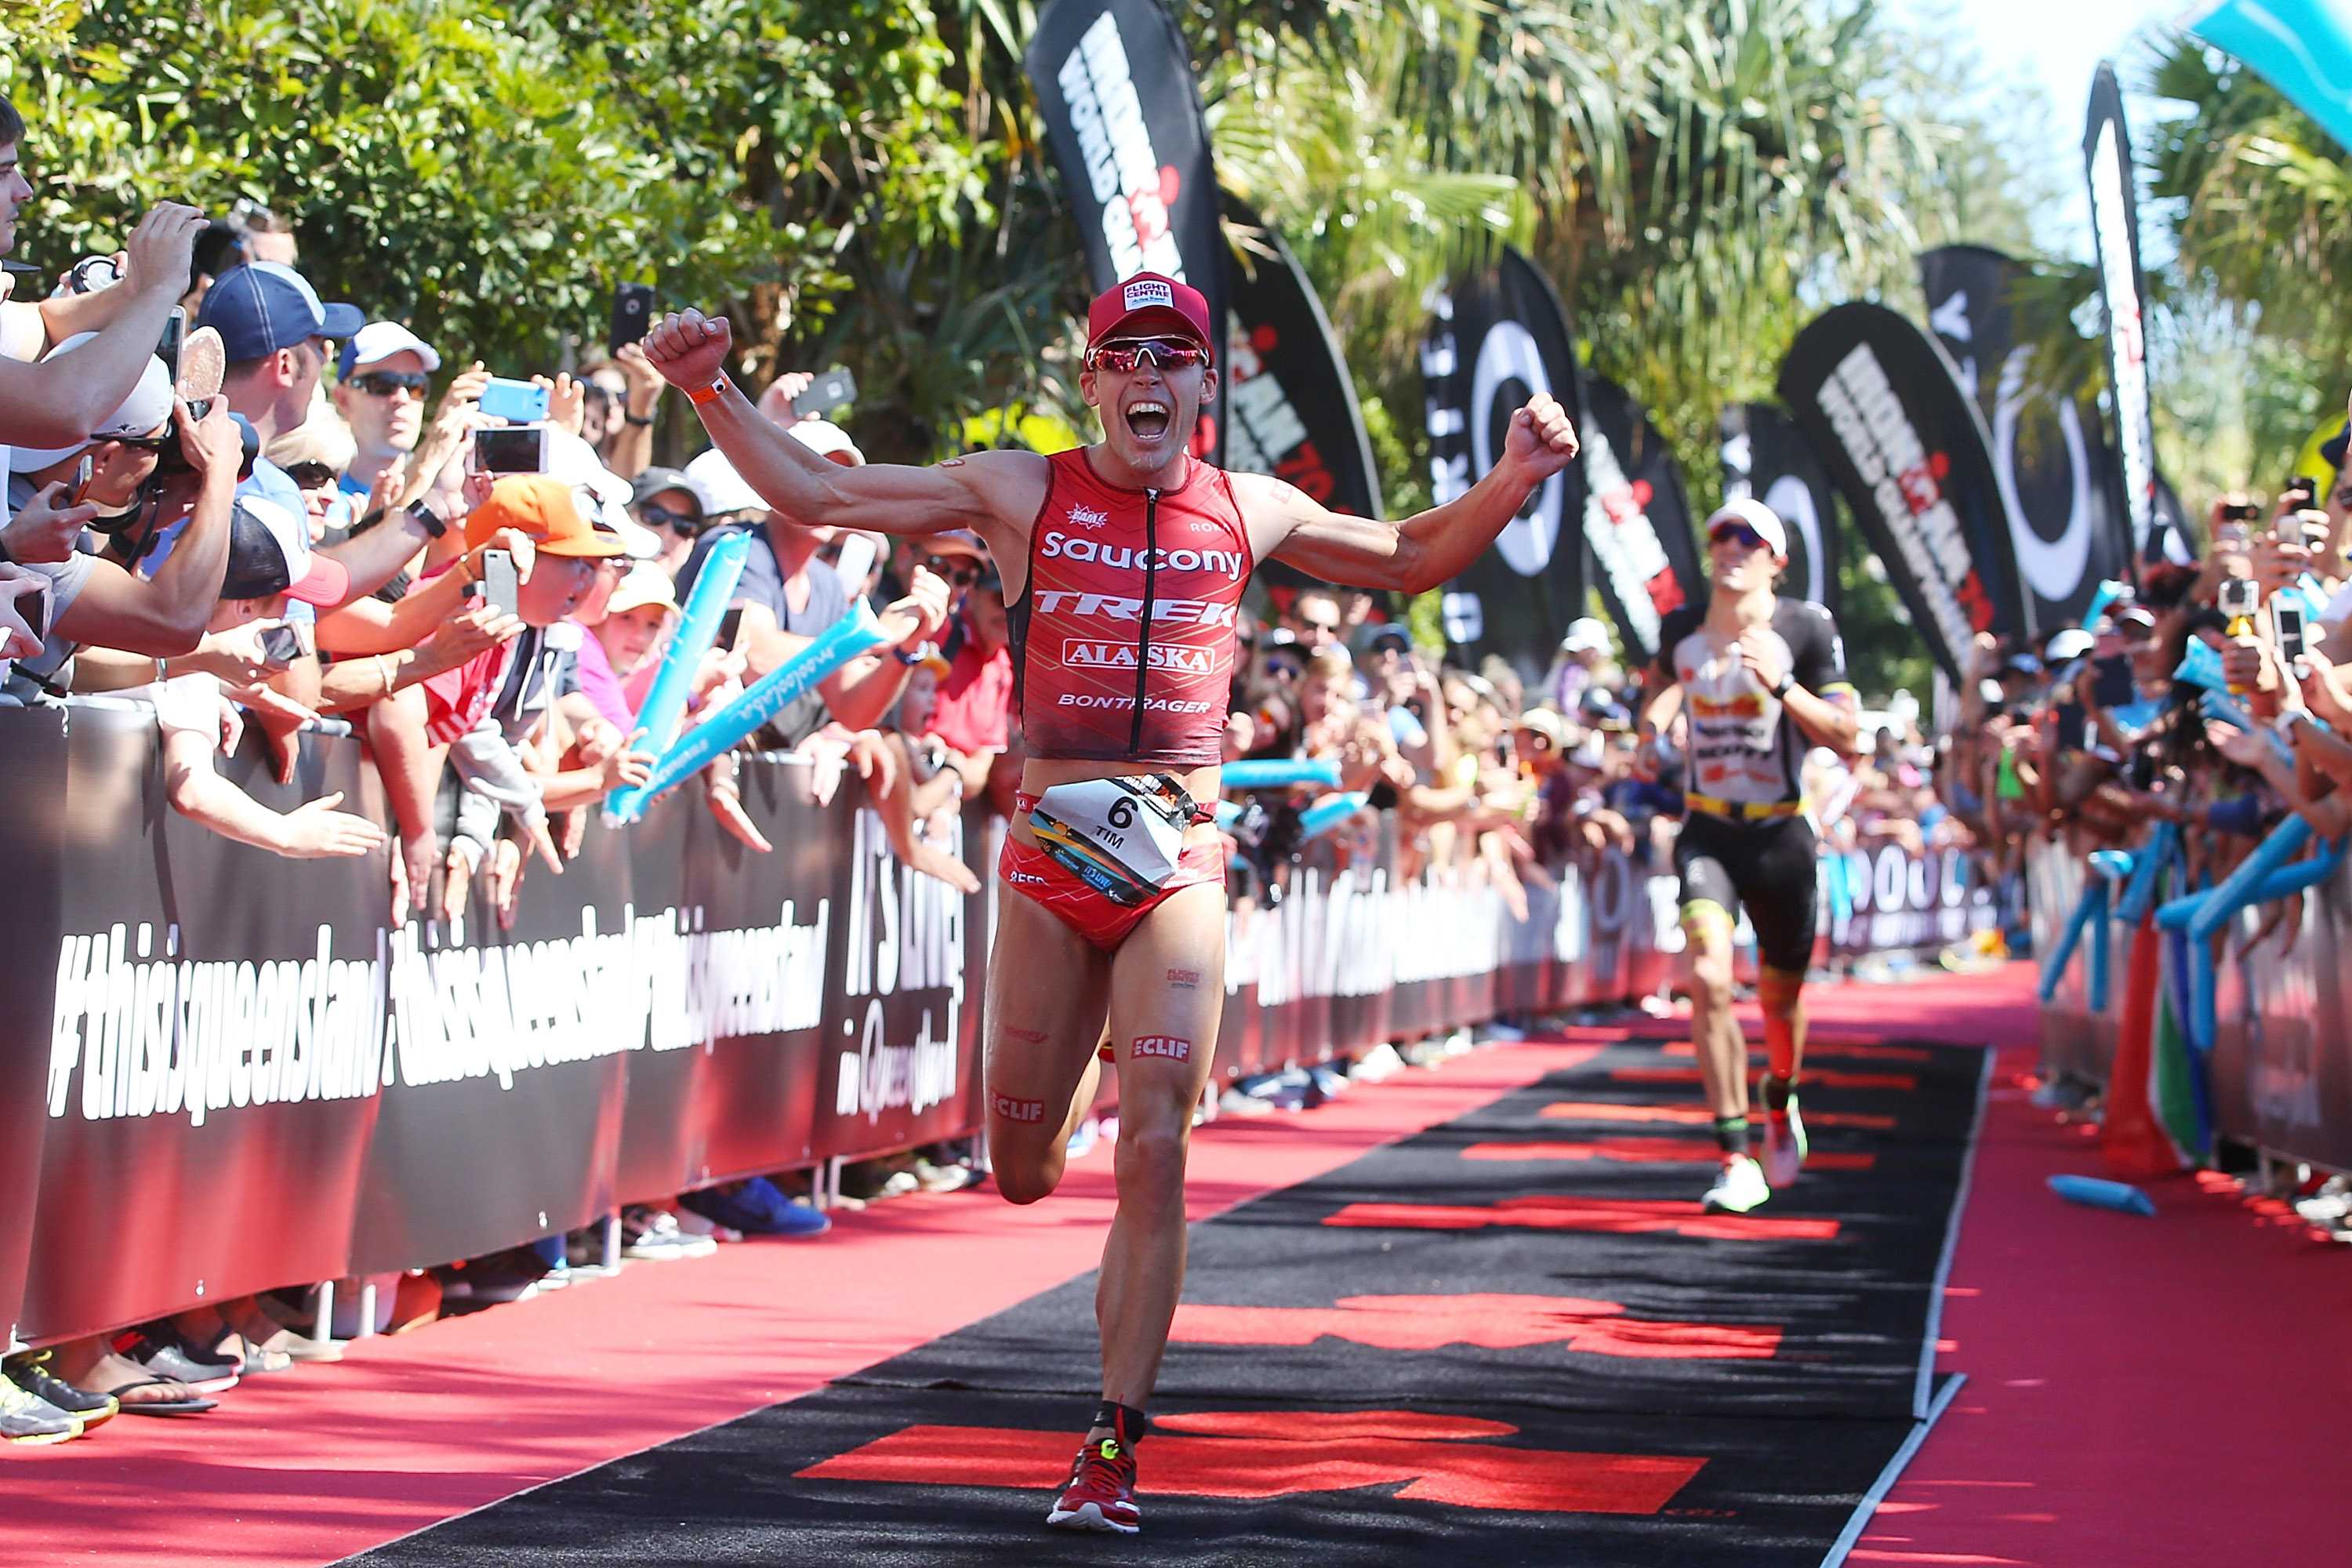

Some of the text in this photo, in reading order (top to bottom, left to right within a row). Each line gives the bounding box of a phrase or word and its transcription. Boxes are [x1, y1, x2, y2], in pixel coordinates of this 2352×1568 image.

[1127, 283, 1167, 292] FLIGHT
[1421, 276, 1483, 643] OKLEY
[1034, 590, 1238, 628] TREK
[1068, 643, 1209, 671] ALASKA
[1058, 693, 1211, 713] BONTRAGER
[1107, 796, 1139, 829] 6
[1096, 825, 1124, 850] TIM
